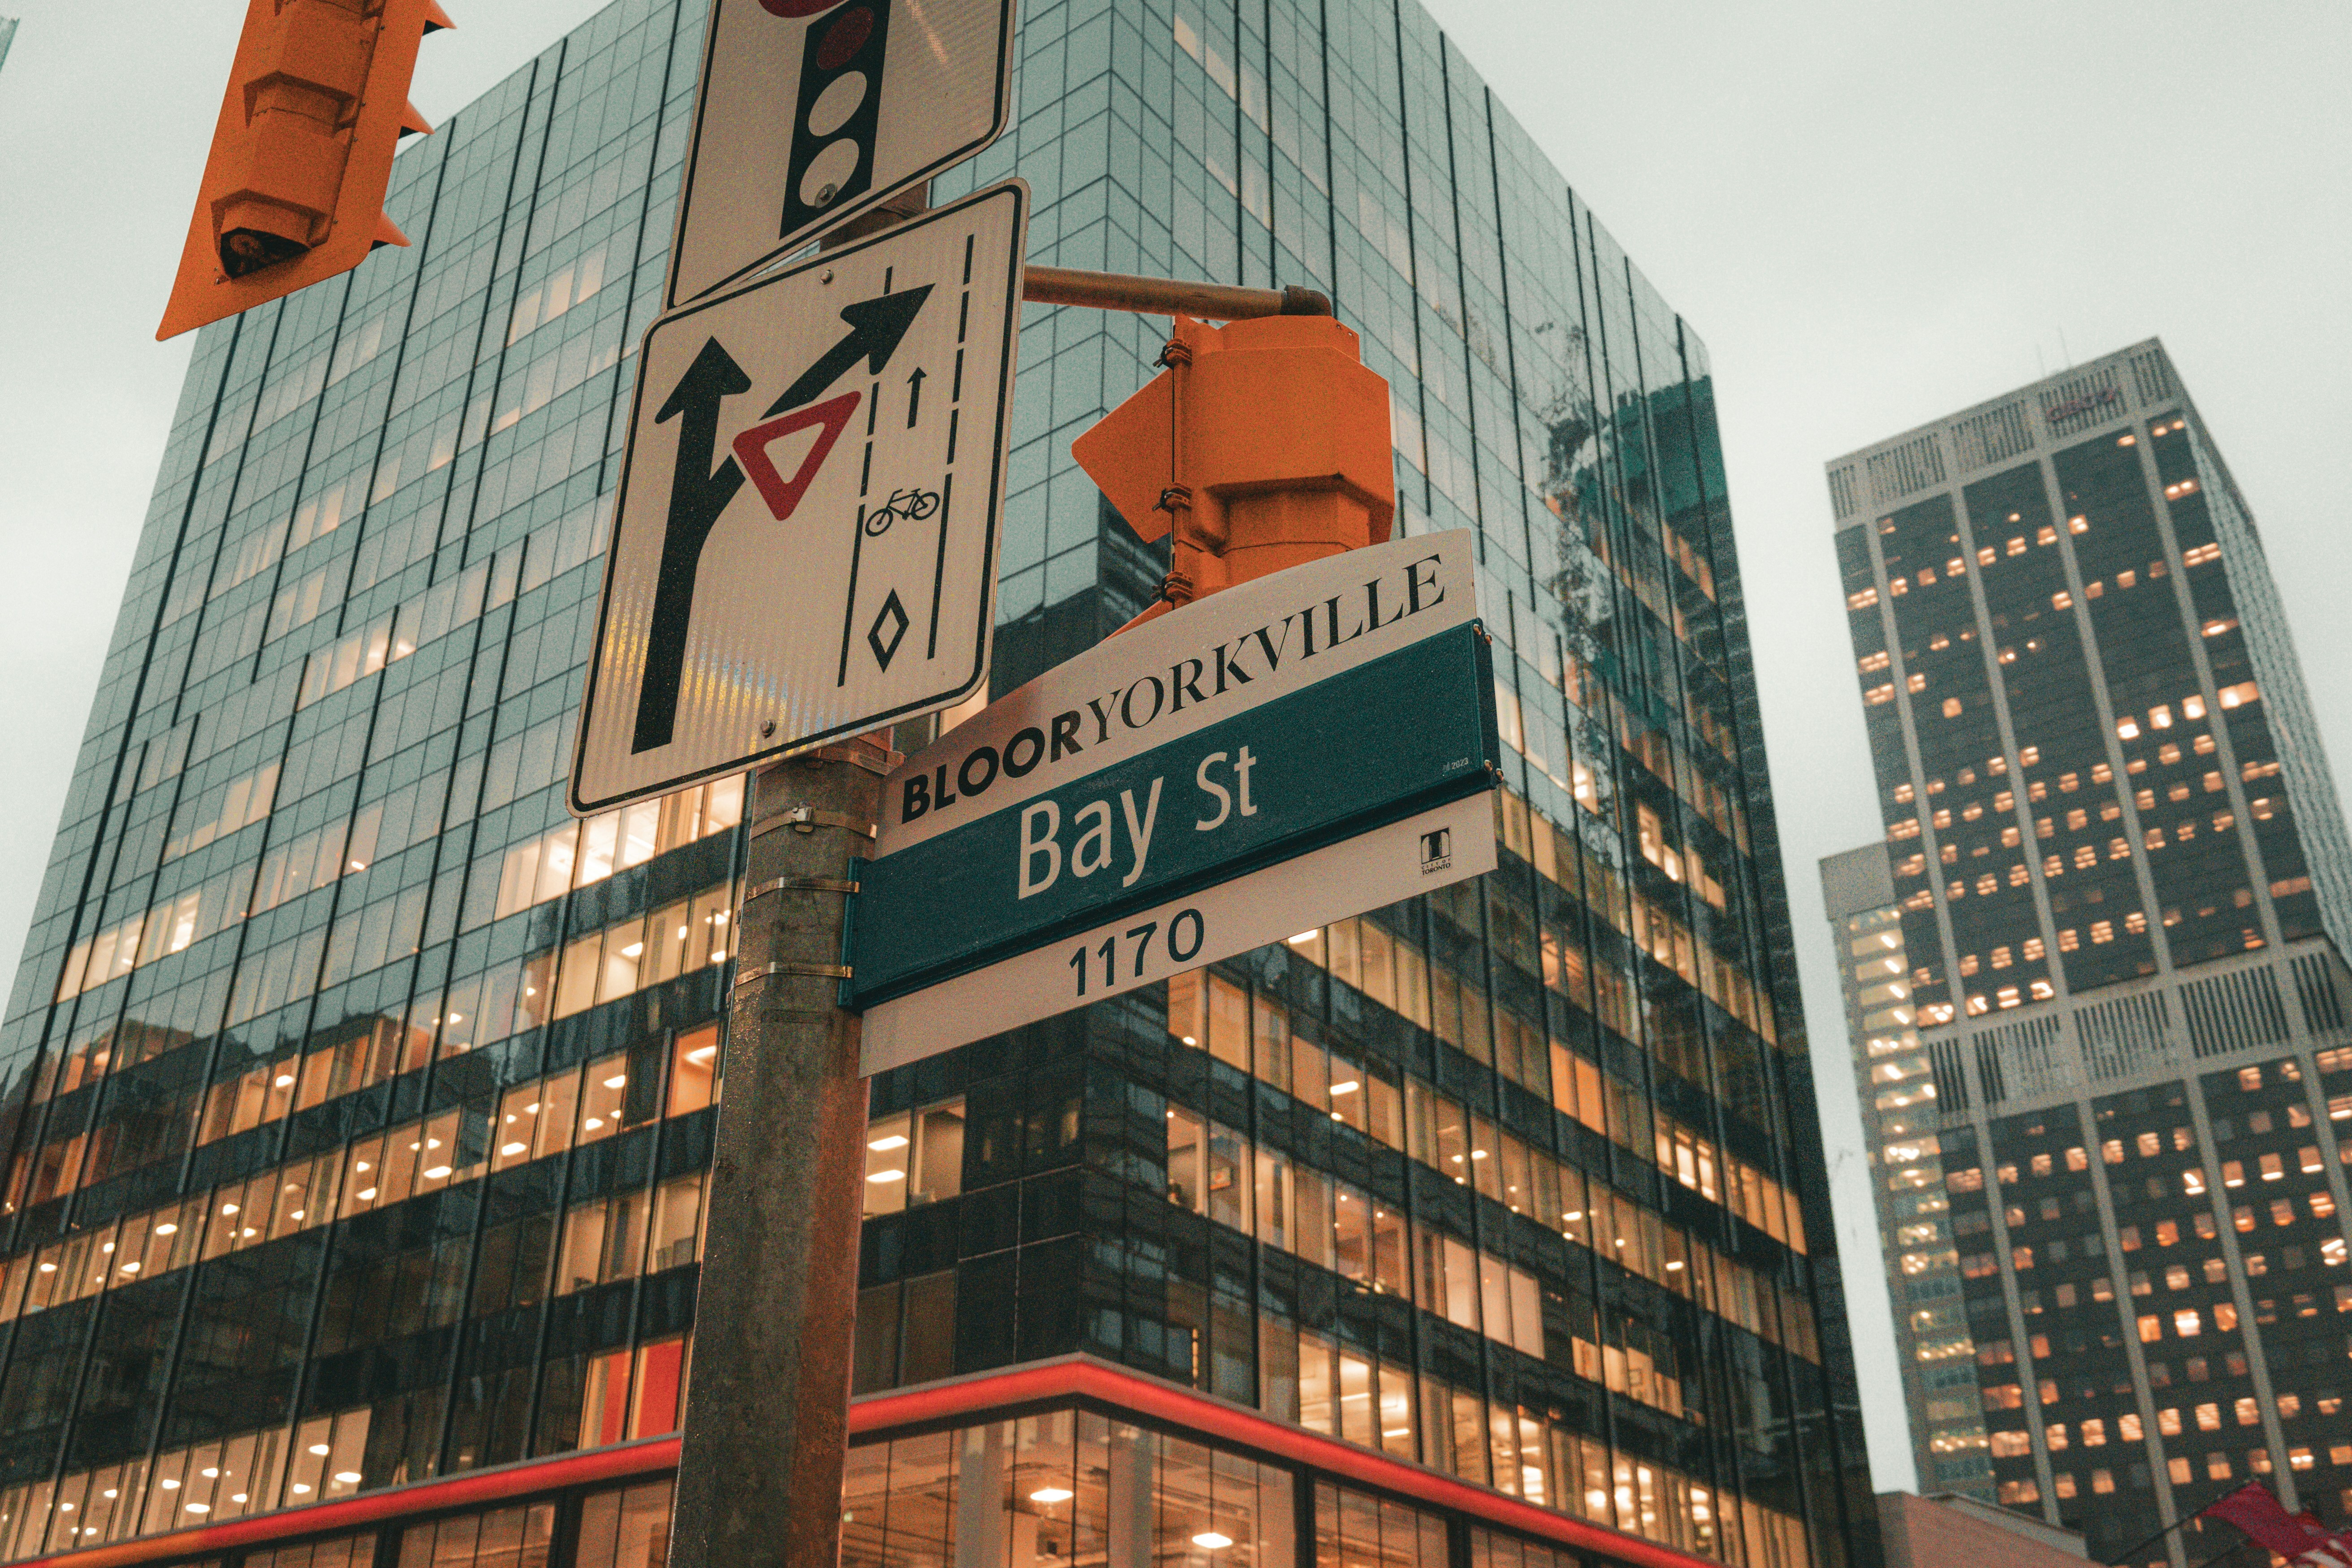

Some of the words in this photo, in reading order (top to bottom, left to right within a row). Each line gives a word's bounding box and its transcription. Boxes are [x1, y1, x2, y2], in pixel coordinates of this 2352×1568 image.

[1017, 776, 1164, 900] Bay
[1195, 745, 1257, 831] St
[1422, 862, 1451, 875] TORONTO
[1069, 908, 1204, 997] 1170
